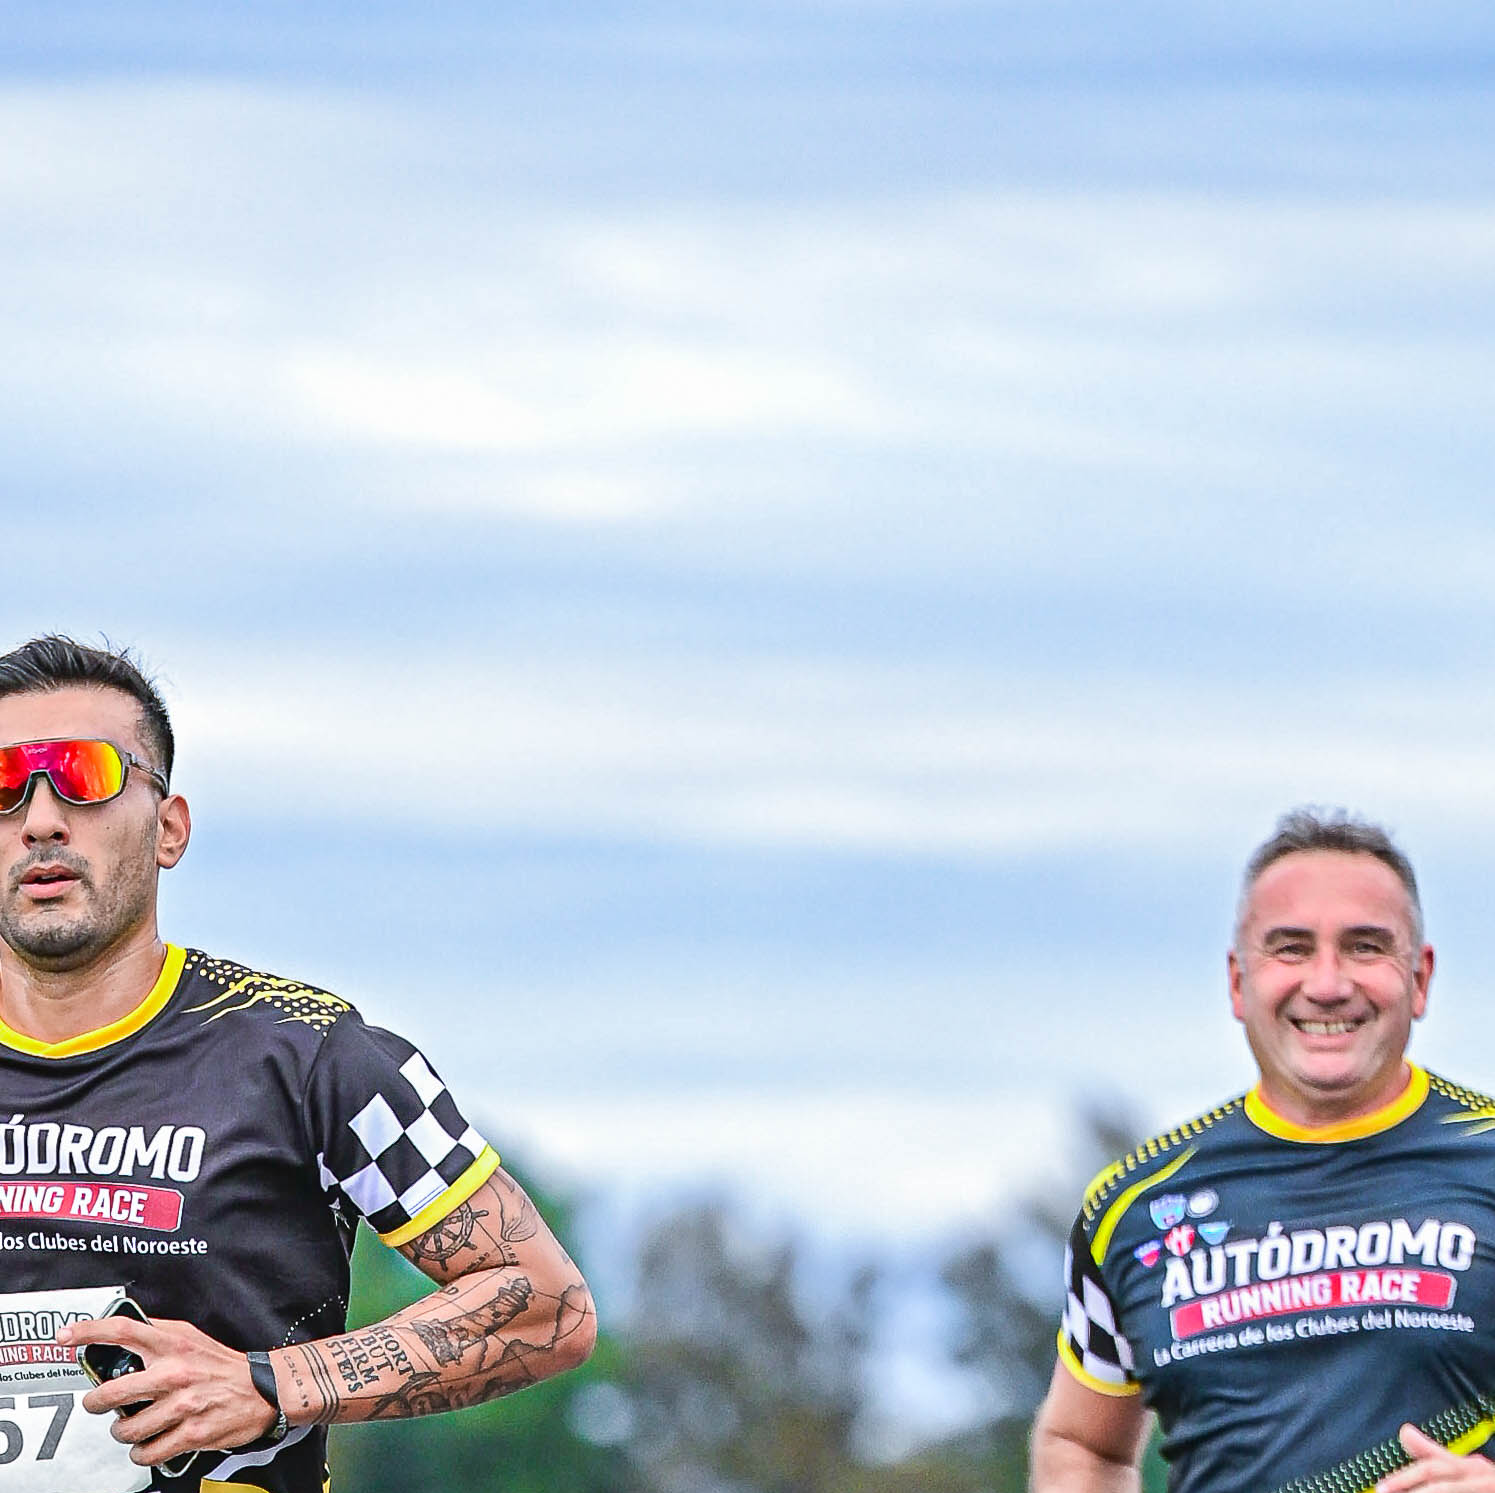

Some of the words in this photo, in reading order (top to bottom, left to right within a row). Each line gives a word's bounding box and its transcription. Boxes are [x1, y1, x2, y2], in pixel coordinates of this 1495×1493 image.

[70, 1187, 149, 1225] RACE
[27, 1232, 87, 1252] Clubes
[90, 1234, 119, 1254] del
[123, 1236, 208, 1256] Noroeste
[1160, 1218, 1477, 1308] AUTÓDROMO
[1200, 1275, 1332, 1329] RUNNING
[1340, 1273, 1422, 1303] RACE
[31, 1345, 71, 1363] RACE
[360, 1335, 394, 1371] BUT
[1171, 1333, 1238, 1361] Carrera
[1238, 1326, 1265, 1347] de
[1266, 1322, 1295, 1343] los
[1295, 1314, 1360, 1338] Clubes
[1361, 1308, 1392, 1331] del
[1394, 1308, 1475, 1333] Noroeste
[0, 1373, 13, 1383] los
[14, 1370, 46, 1381] Clubes
[46, 1369, 61, 1379] del
[325, 1340, 364, 1393] STEPS
[341, 1337, 380, 1384] FIRM
